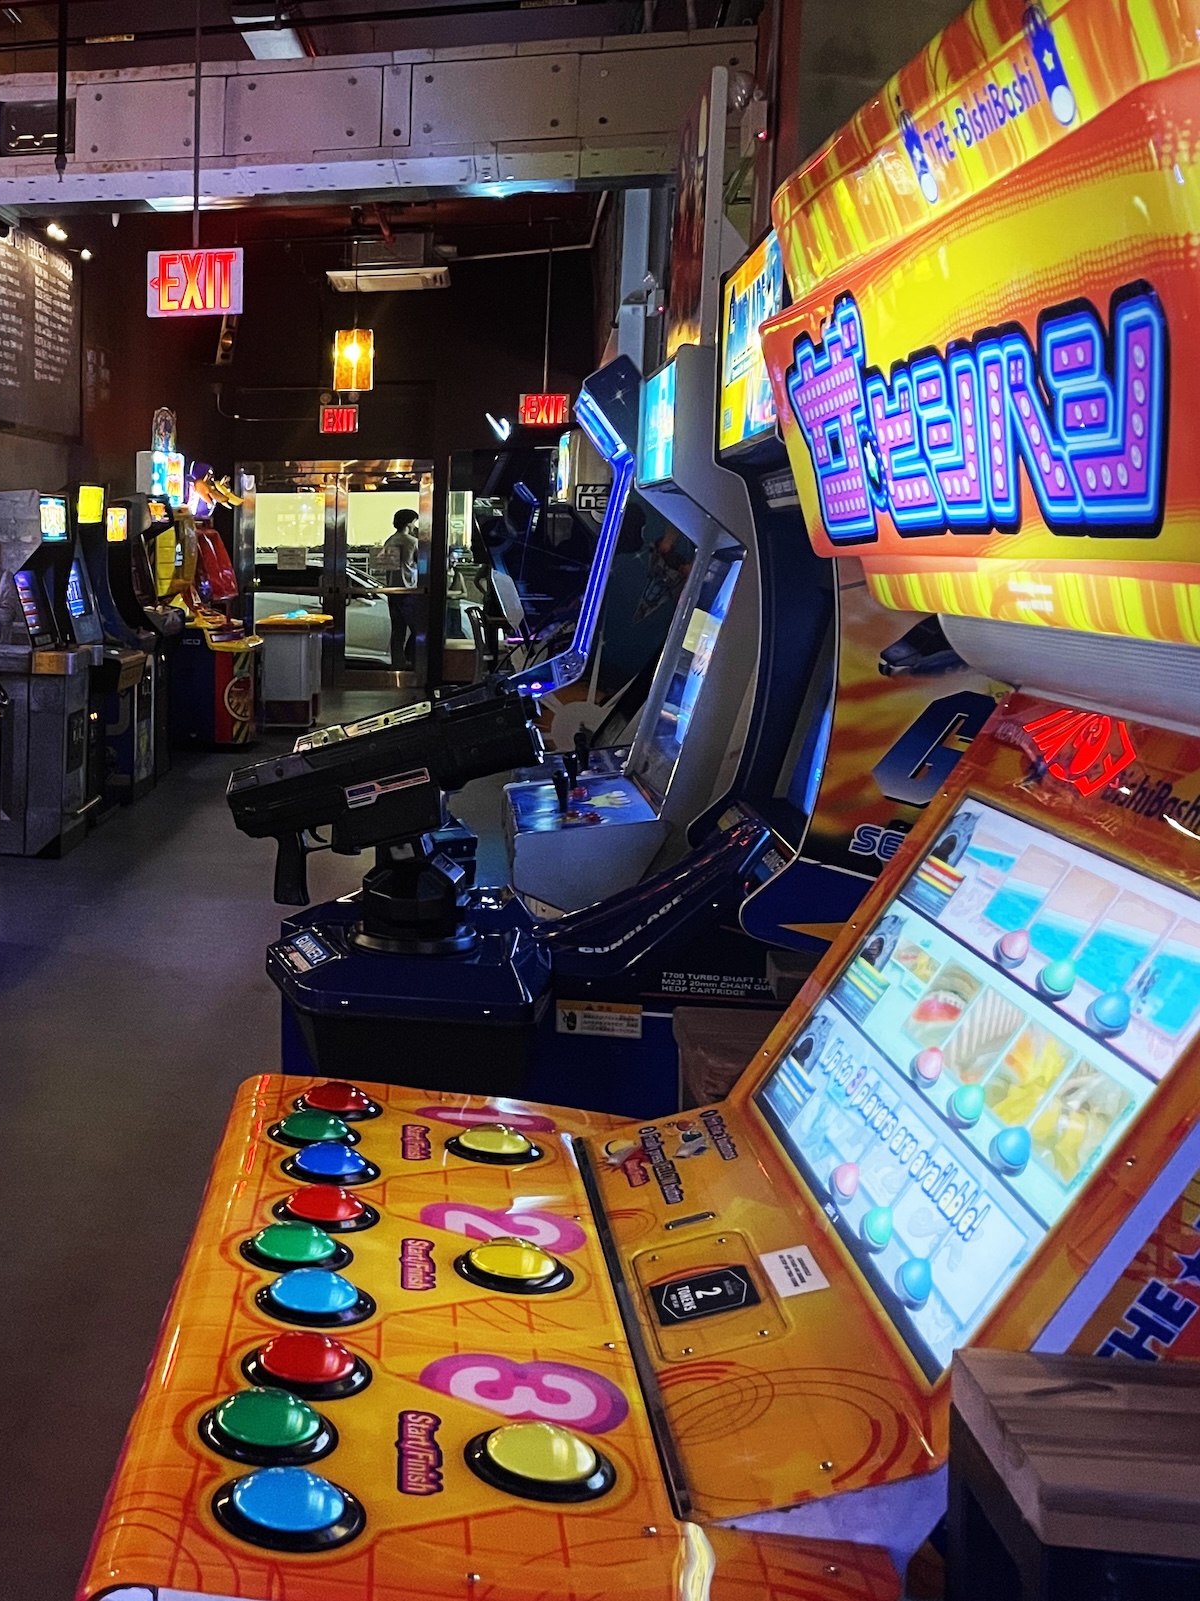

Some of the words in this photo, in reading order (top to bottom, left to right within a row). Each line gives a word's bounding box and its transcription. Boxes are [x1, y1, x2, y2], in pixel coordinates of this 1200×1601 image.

[923, 121, 955, 165] THE
[955, 57, 1041, 147] BishiBashi
[158, 251, 236, 312] EXIT
[323, 407, 357, 432] EXIT
[524, 395, 566, 424] EXIT
[578, 894, 684, 953] GUNBLADE
[661, 971, 684, 979] T700
[687, 973, 720, 981] TURBO
[722, 974, 755, 983] SHAFT
[661, 978, 687, 986] M237
[689, 980, 718, 988] 20mm
[719, 981, 752, 990] CHAIN
[661, 985, 688, 993] HEDP
[689, 986, 746, 997] CARTRIDGE
[847, 1067, 863, 1097] 3
[856, 1079, 893, 1141] players
[891, 1124, 917, 1162] are
[912, 1142, 991, 1241] available!
[444, 1210, 561, 1248] 2
[401, 1239, 435, 1291] Start/Finish
[676, 1285, 698, 1312] TOKENS
[695, 1286, 722, 1300] 2
[450, 1366, 598, 1421] 3
[399, 1411, 443, 1496] Start/Finish
